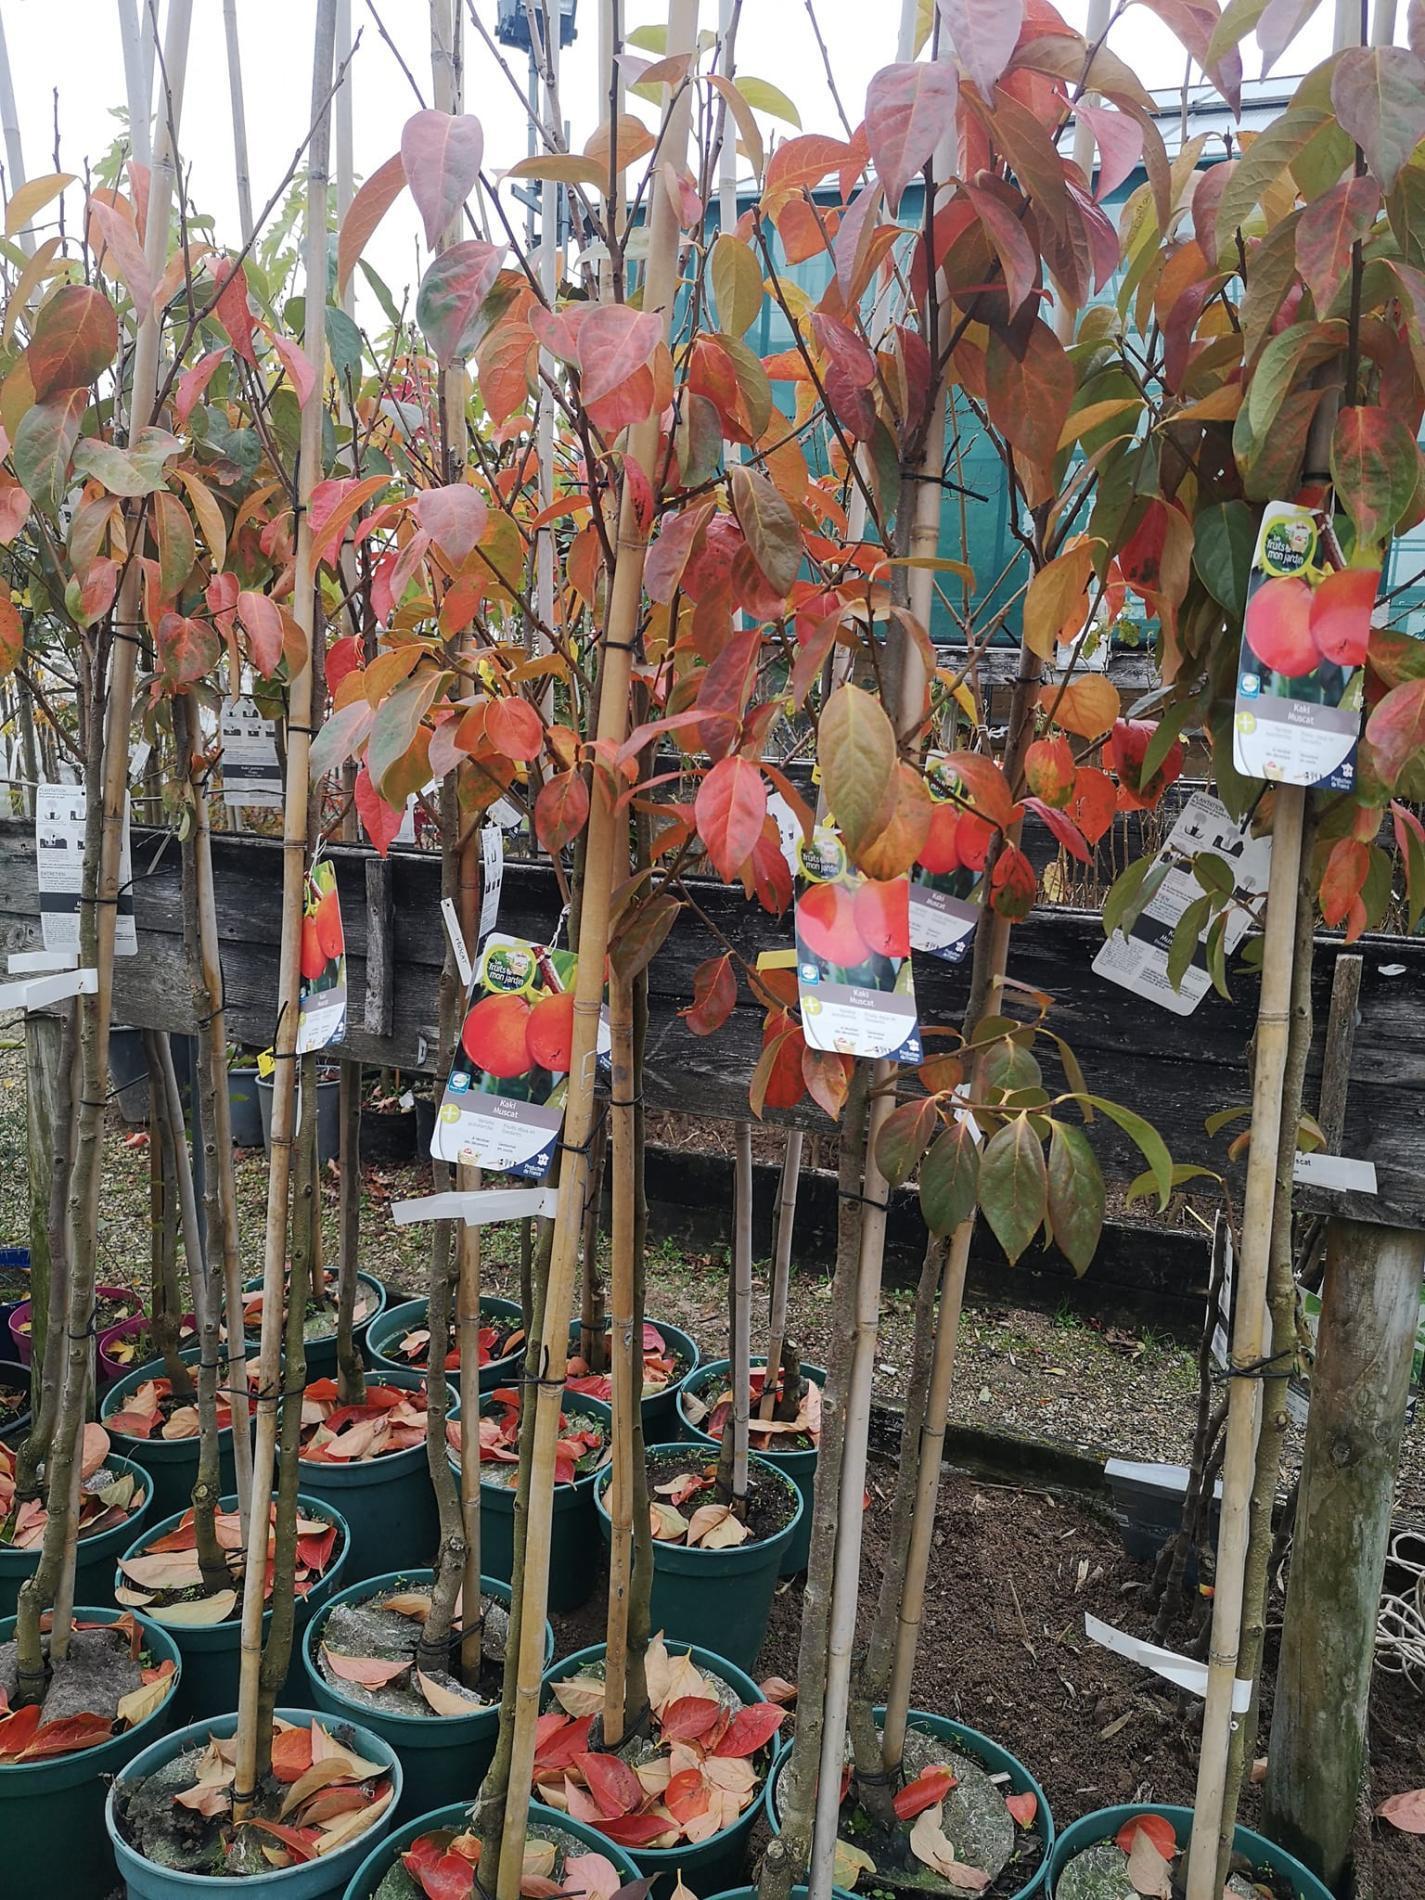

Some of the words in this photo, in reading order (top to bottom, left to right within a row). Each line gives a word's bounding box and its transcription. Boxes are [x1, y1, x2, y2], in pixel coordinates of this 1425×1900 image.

[1267, 538, 1286, 552] fruits
[1267, 550, 1284, 561] mon
[1282, 552, 1304, 565] jardin
[1293, 703, 1311, 714] Kaki
[1287, 712, 1315, 725] Muscat
[1193, 795, 1225, 812] PLANTATION
[805, 861, 820, 871] mon
[489, 963, 506, 974] fruits
[489, 971, 505, 981] mon
[503, 975, 524, 986] jardin
[852, 989, 870, 999] Kaki
[849, 996, 875, 1007] Muscat
[499, 1099, 517, 1110] Kaki
[492, 1107, 520, 1119] Muscat
